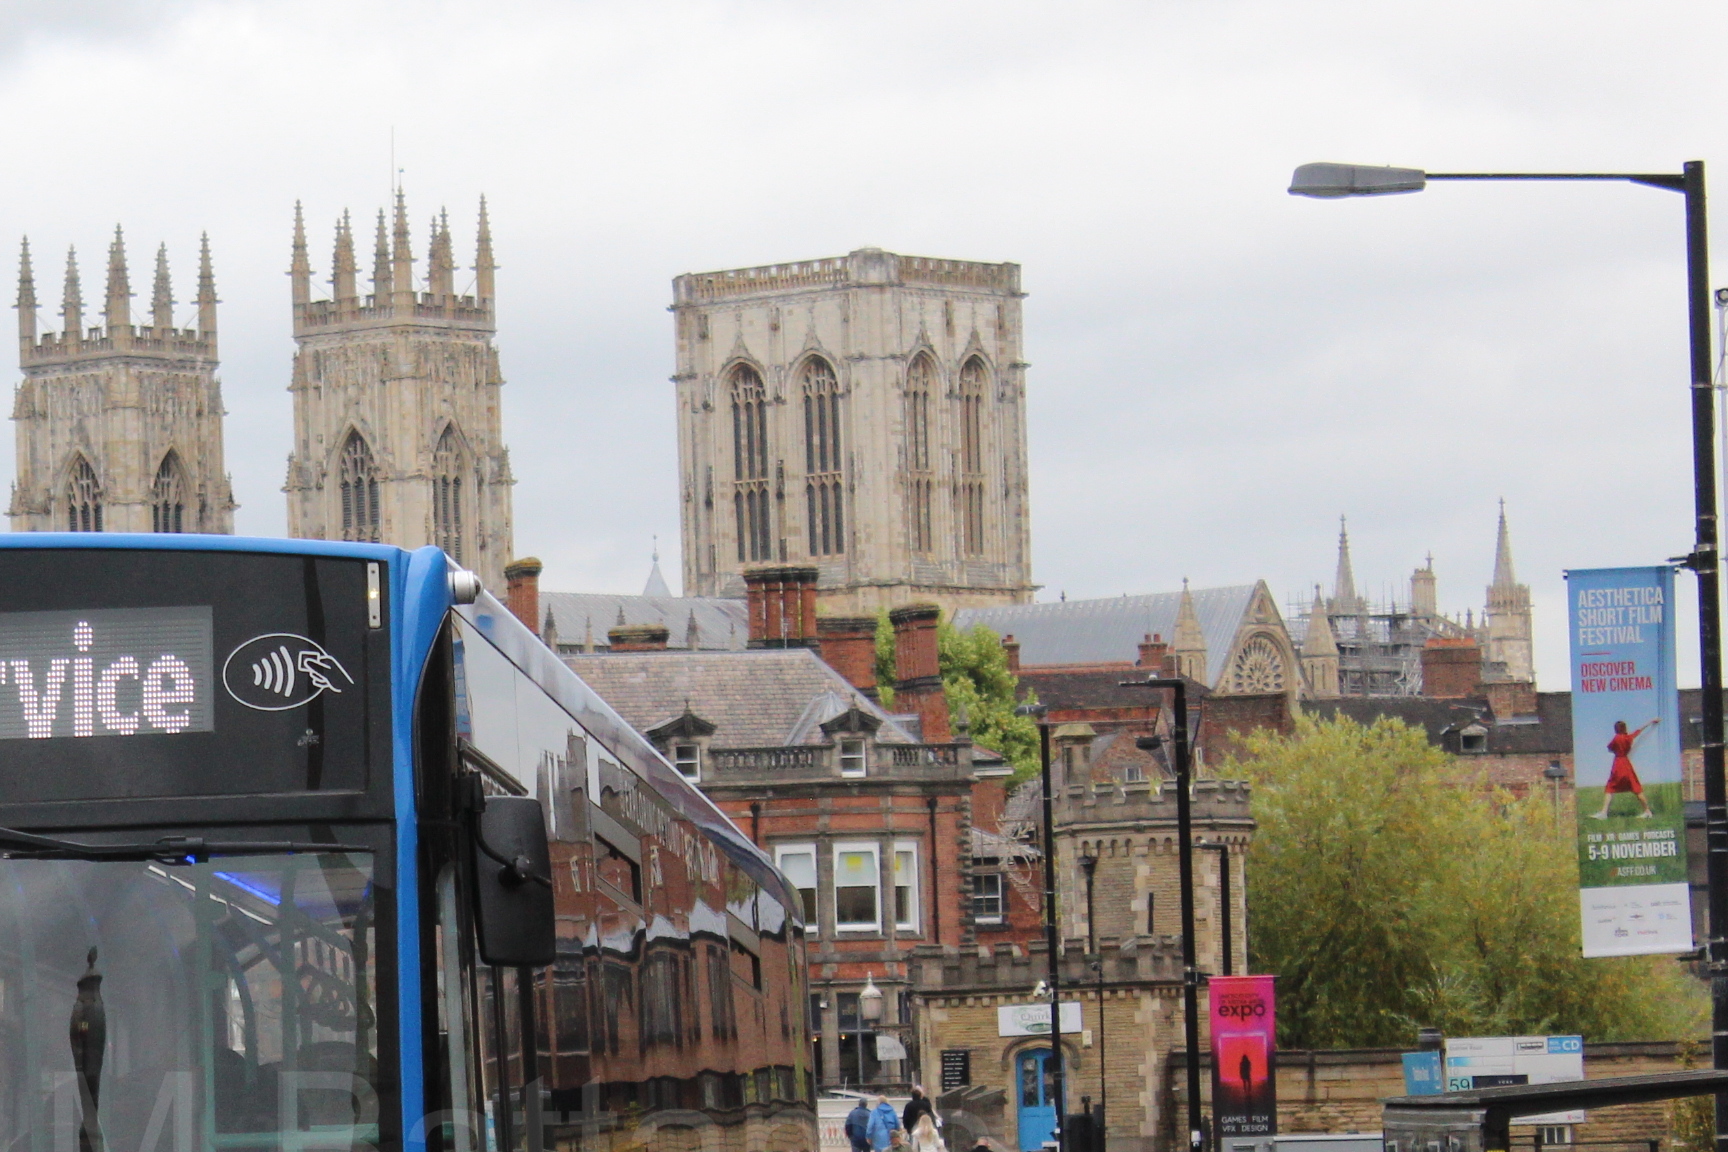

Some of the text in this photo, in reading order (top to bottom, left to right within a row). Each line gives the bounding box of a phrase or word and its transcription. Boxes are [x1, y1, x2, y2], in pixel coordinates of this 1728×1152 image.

[1578, 587, 1664, 608] AESTHETICA
[1578, 605, 1662, 627] SHORT FILM
[1579, 625, 1644, 646] FESTIVAL
[1581, 661, 1635, 677] DISCOVER
[1581, 676, 1653, 693] NEW CINEMA
[1588, 841, 1677, 860] 5-9 NOVEMBER
[1218, 1003, 1266, 1022] expo
[1562, 1040, 1580, 1051] CD
[1449, 1078, 1470, 1091] 59
[1221, 1114, 1268, 1124] GAMES FILM
[1222, 1124, 1268, 1133] VFX DESIGN
